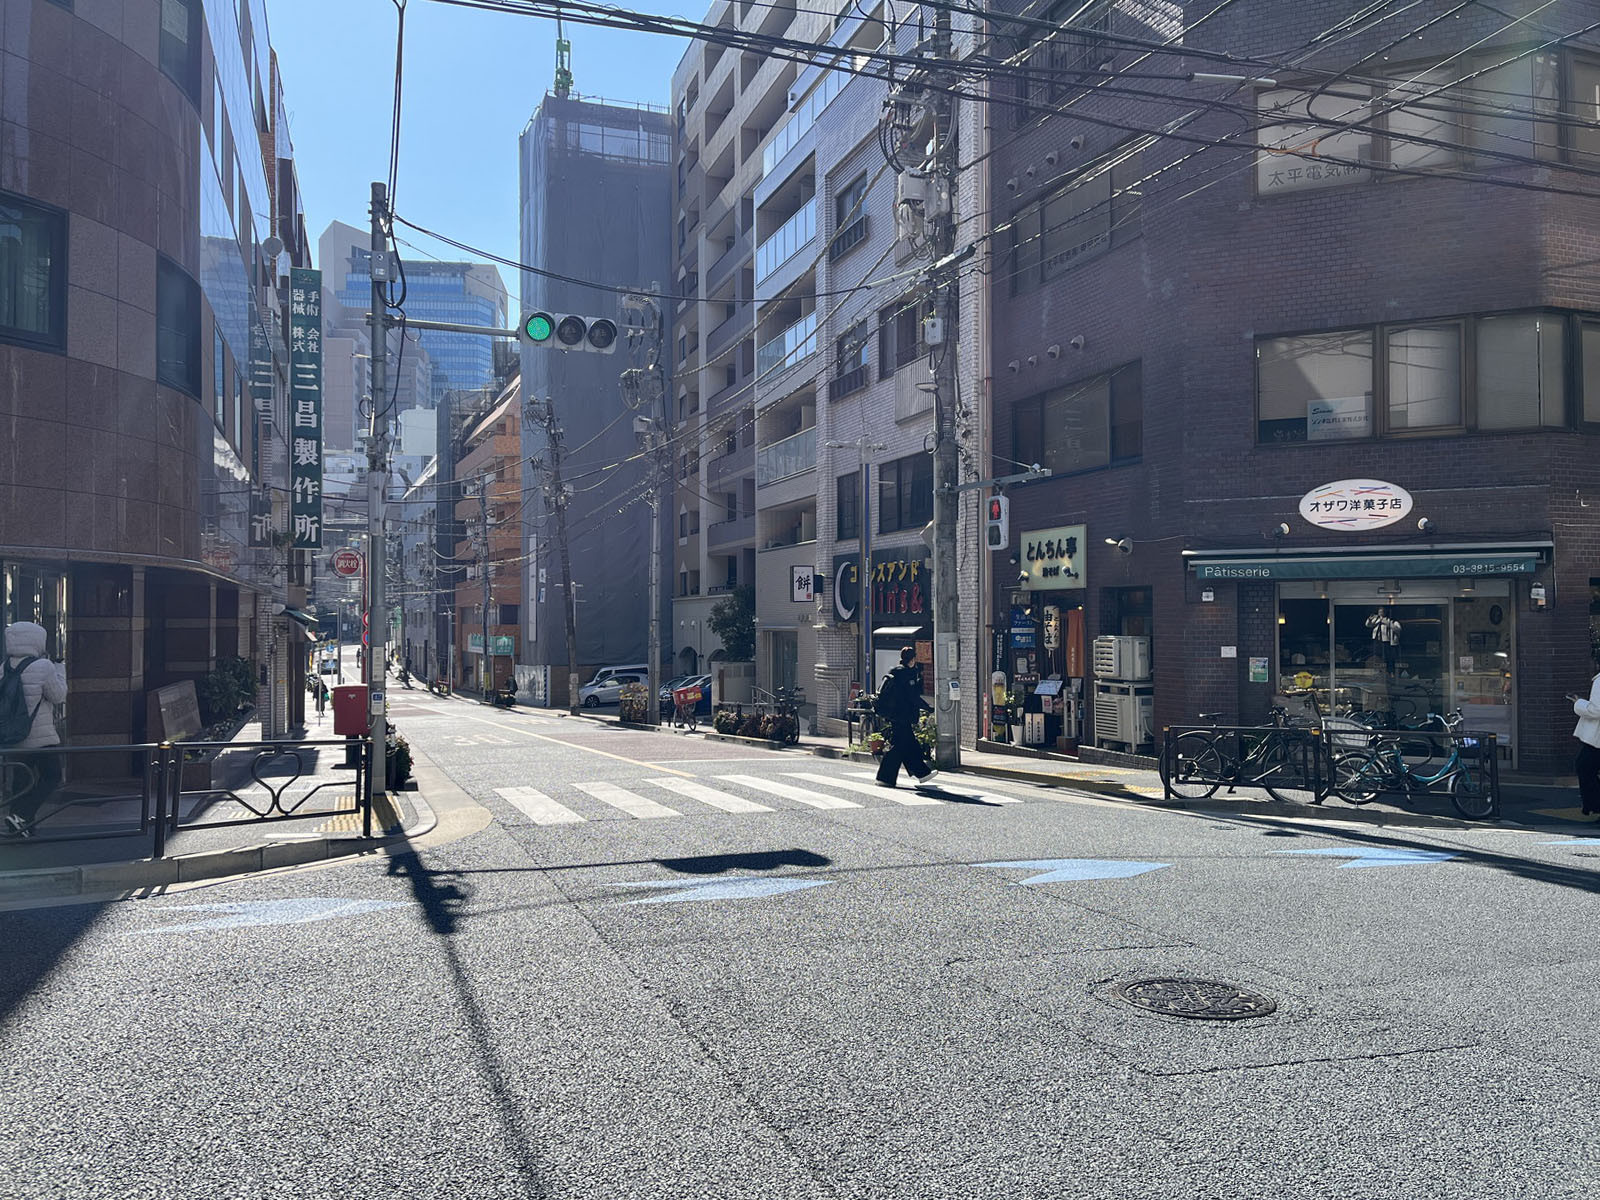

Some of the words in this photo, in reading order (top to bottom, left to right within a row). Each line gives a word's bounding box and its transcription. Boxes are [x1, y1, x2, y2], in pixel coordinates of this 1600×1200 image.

[292, 288, 306, 316] 器械
[306, 291, 320, 317] 手術
[292, 327, 306, 353] 株式
[306, 328, 320, 353] 会社
[293, 363, 319, 543] 三昌製作所
[1309, 498, 1402, 513] オザワ洋菓子店
[1026, 536, 1078, 561] とんちん亭
[337, 559, 358, 569] 消火栓
[1204, 565, 1270, 577] Pâtisserie
[795, 574, 812, 592] 餅
